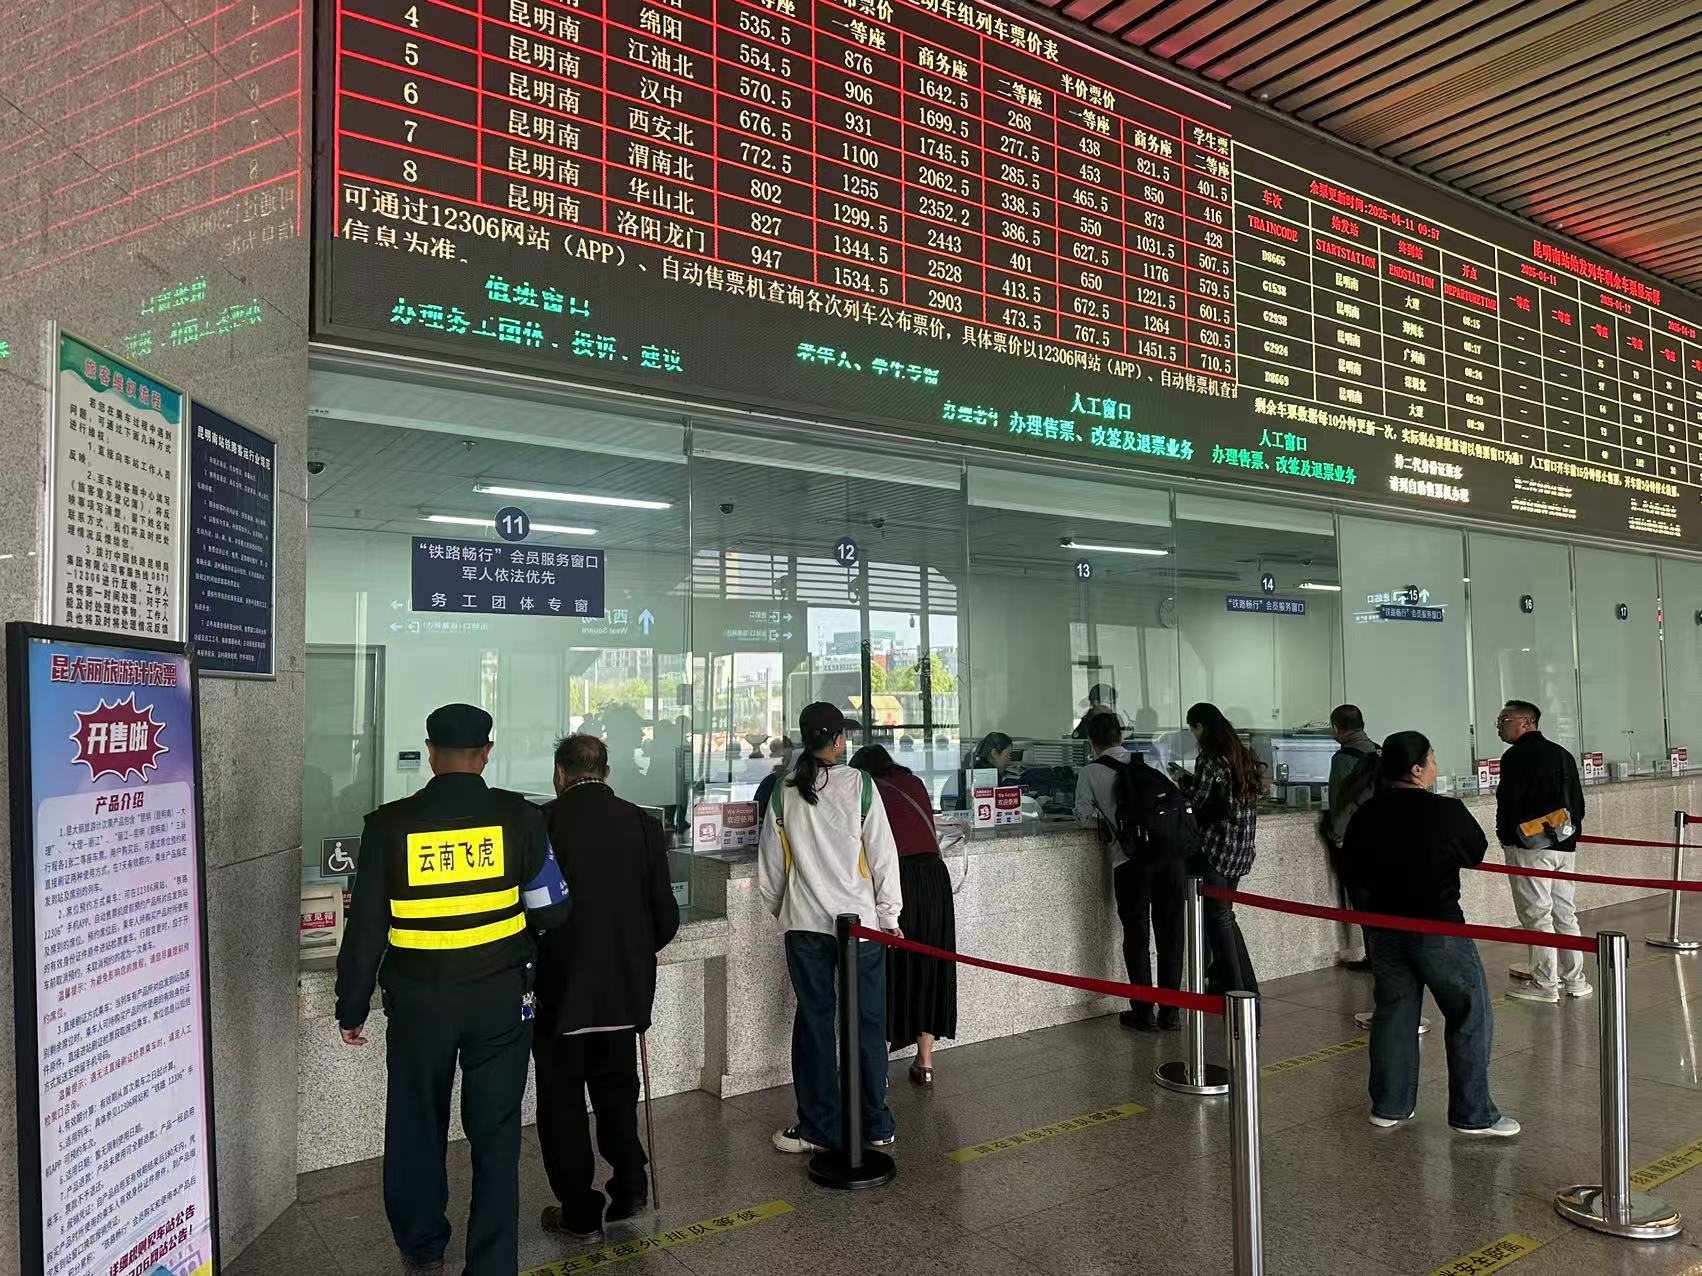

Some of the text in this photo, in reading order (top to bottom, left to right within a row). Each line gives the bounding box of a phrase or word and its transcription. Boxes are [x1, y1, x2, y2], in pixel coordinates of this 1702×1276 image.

[833, 19, 886, 51] 一等座
[918, 47, 967, 82] 商务座
[997, 79, 1043, 109] 二等座
[1068, 108, 1110, 136] 一等座
[1134, 129, 1172, 158] 商务座
[1060, 74, 1115, 111] 半价票价
[640, 7, 1223, 225] 绵阳 554.5 906 1699.5 416
[740, 11, 1228, 202] 535.5 876 1642.5 401.5
[404, 6, 1230, 276] 4 昆明南 汉中 676.5 1100 2062.5 507.5
[508, 0, 1223, 249] 昆明南 江油北 570.5 931 1745.5 428
[1193, 127, 1229, 155] 学生票
[404, 43, 1230, 300] 5 昆明南 西安北 772.5 1255 2352.2 579.5
[1194, 154, 1229, 178] 二等座
[404, 82, 1231, 325] 6 昆明南 渭南北 802 1299.5 2443 601.5
[404, 120, 1231, 349] 7 昆明南 华山北 827 1344.5 2528 620.5
[1262, 189, 1283, 210] 车次
[1331, 215, 1360, 238] 始发站
[1461, 264, 1478, 281] 开点
[403, 160, 1232, 374] 8 昆明南 洛阳龙门 947 1534.5 2903 710.5
[1248, 214, 1497, 311] TRAINCODE STARTSTATION ENDSTATION DEPARTURETIME
[1070, 392, 1132, 420] 人工窗口
[1009, 411, 1194, 461] 办理售票、改签及退票业务
[1259, 429, 1307, 452] 人工窗口
[1211, 444, 1357, 484] 办理售票、改签及退票业务
[502, 515, 524, 535] 11
[837, 543, 855, 560] 12
[462, 567, 556, 585] 军人依法优先
[1076, 563, 1090, 578] 13
[1262, 578, 1274, 592] 14
[431, 593, 589, 613] 务工团体专窗
[1408, 589, 1418, 601] 15
[1620, 607, 1628, 617] 17
[51, 654, 177, 687] 昆大丽旅游计次票
[87, 721, 149, 755] 开售啦
[95, 791, 144, 814] 产品介绍
[418, 837, 494, 873] 云南飞虎
